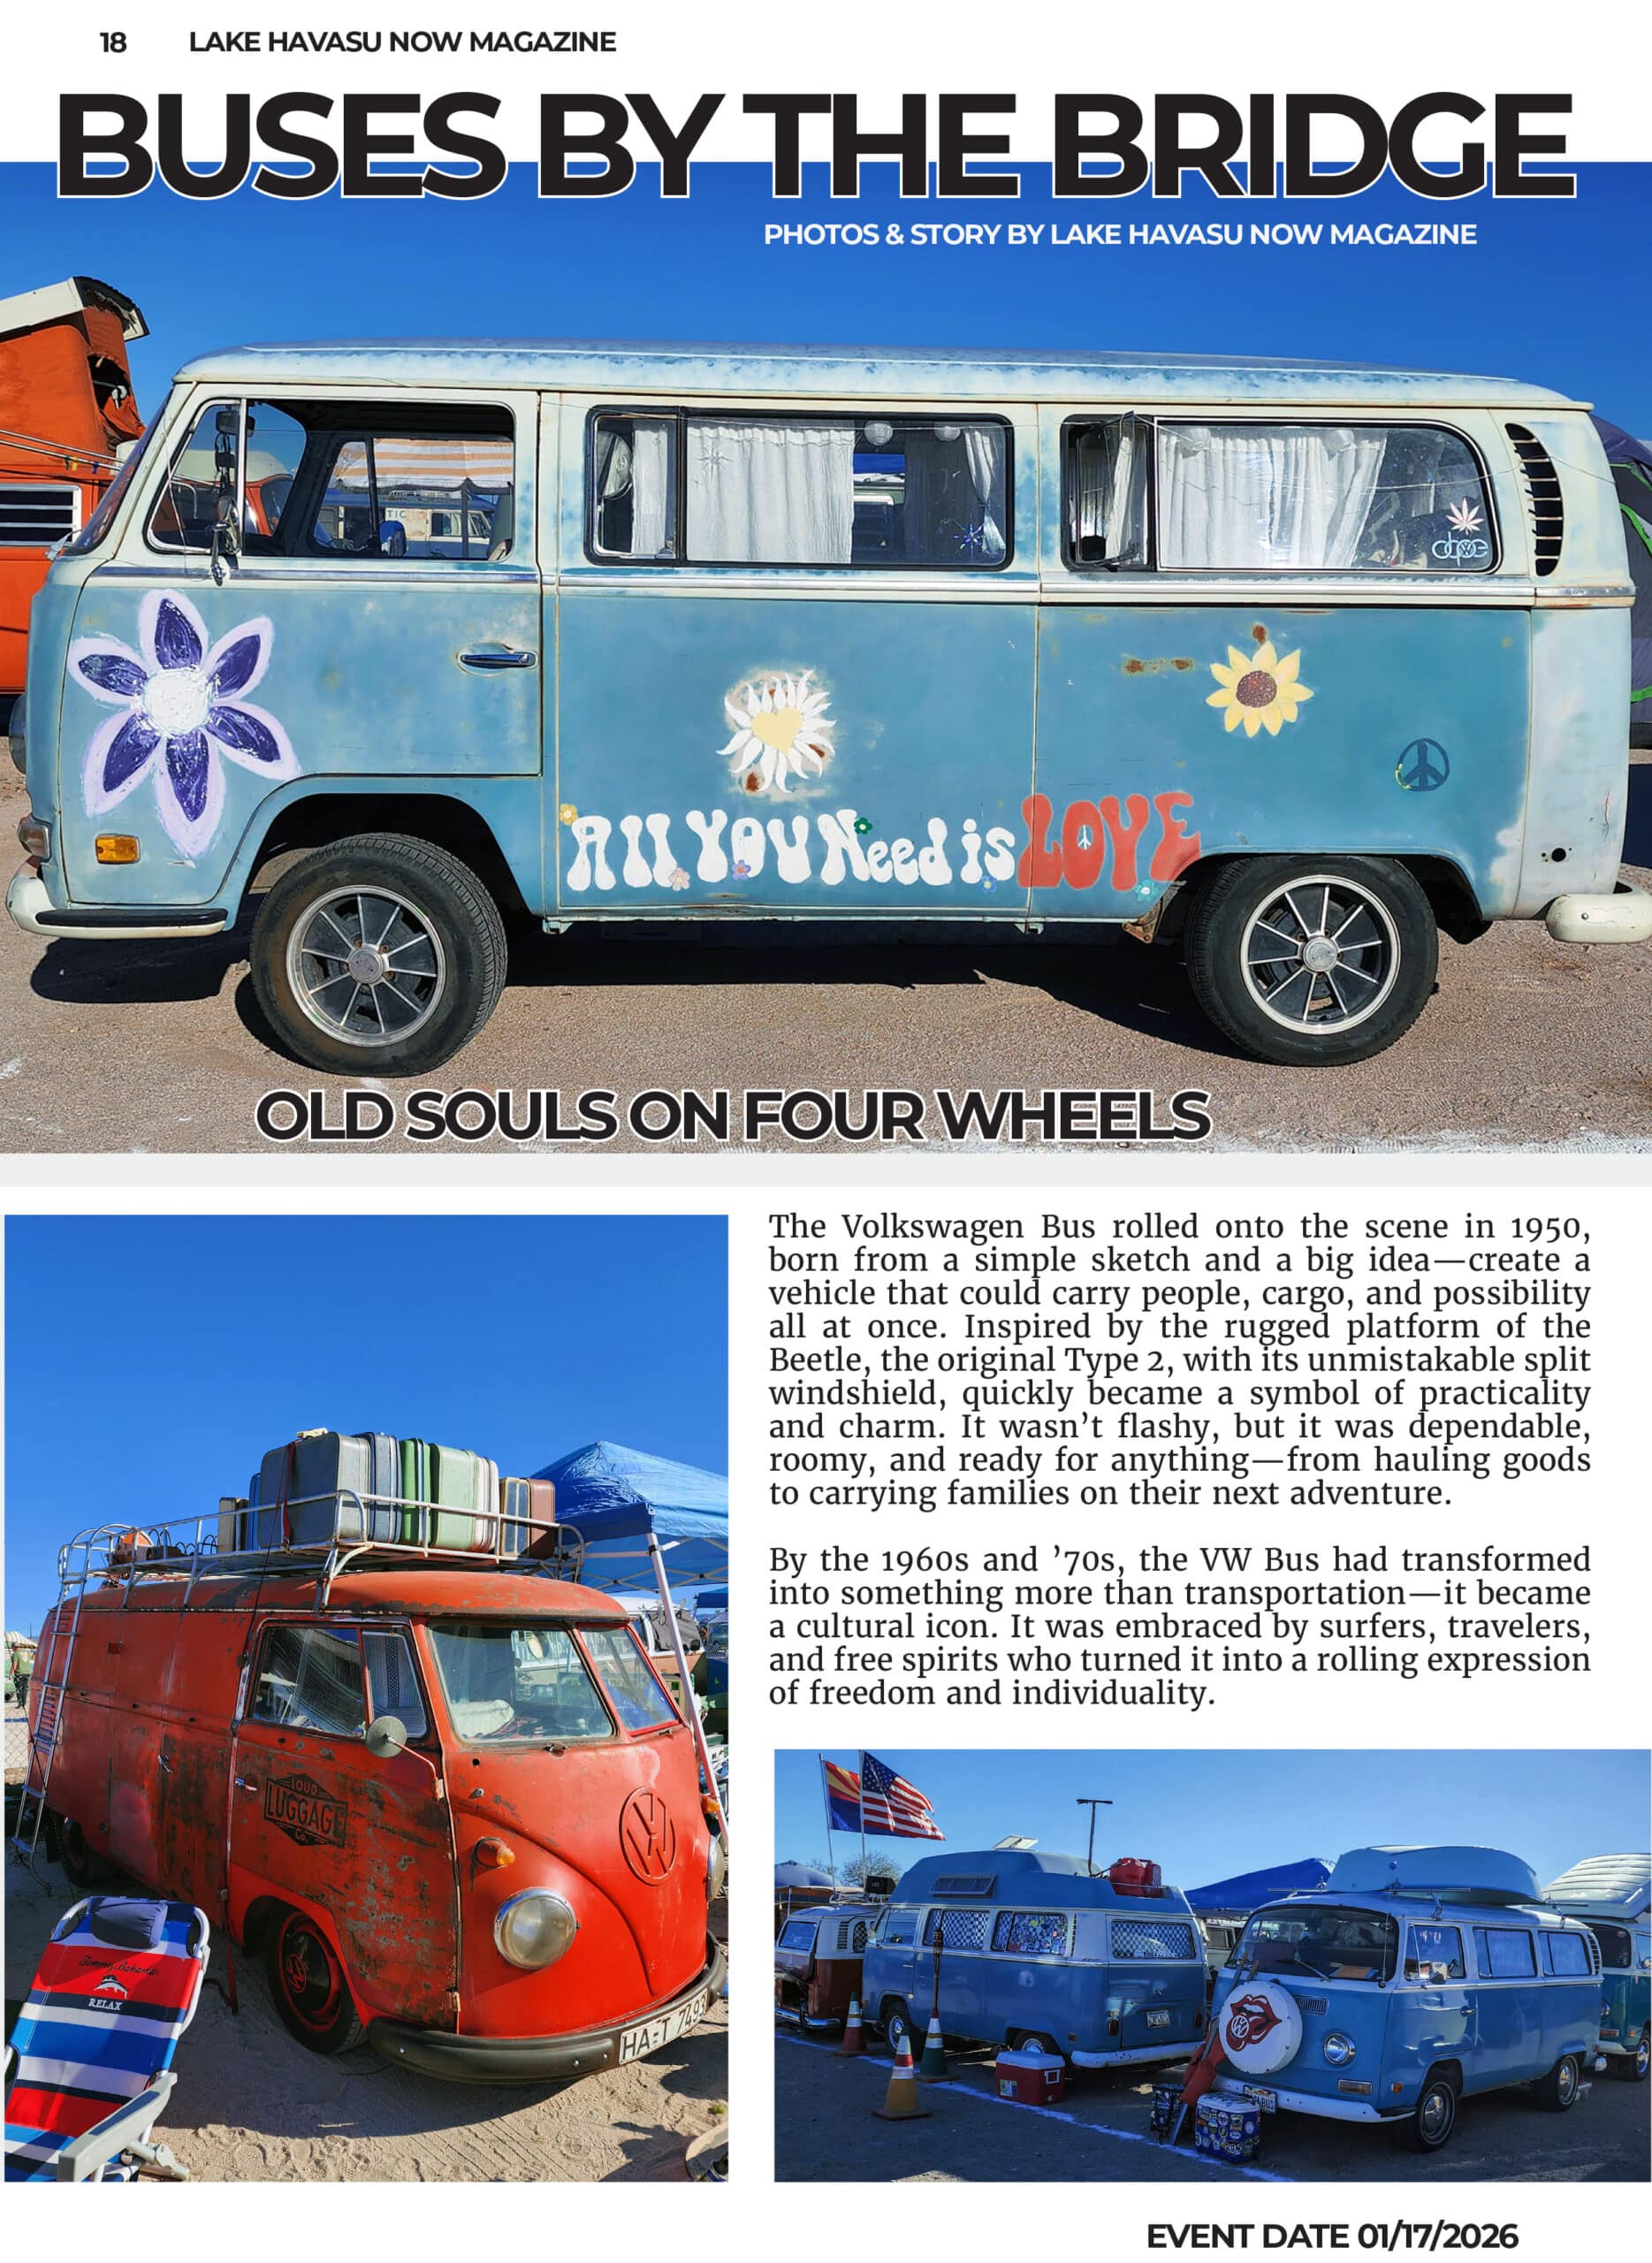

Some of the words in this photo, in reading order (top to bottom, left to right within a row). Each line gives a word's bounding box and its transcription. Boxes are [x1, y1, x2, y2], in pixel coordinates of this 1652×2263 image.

[100, 32, 126, 53] 18
[191, 32, 261, 52] LAKE
[270, 31, 381, 52] HAVASU
[391, 31, 462, 52] NOW
[471, 31, 616, 52] MAGAZINE
[686, 810, 808, 884] YOU
[820, 808, 952, 885] Need
[961, 819, 1016, 883] is
[1018, 793, 1200, 890] LOVE
[769, 1213, 826, 1238] The
[841, 1213, 1024, 1246] Volkswagen
[1042, 1215, 1094, 1238] Bus
[1113, 1213, 1198, 1238] rolled
[1216, 1216, 1283, 1238] onto
[1301, 1213, 1348, 1238] the
[1367, 1220, 1448, 1238] scene
[1465, 1213, 1495, 1238] in
[1512, 1218, 1589, 1244] 1950,
[769, 1246, 839, 1271] born
[855, 1246, 928, 1271] from
[944, 1253, 958, 1271] a
[976, 1246, 1075, 1278] simple
[1092, 1246, 1190, 1271] sketch
[1206, 1246, 1260, 1271] and
[1277, 1253, 1291, 1271] a
[1306, 1246, 1353, 1279] big
[1575, 1253, 1590, 1271] a
[769, 1279, 875, 1305] vehicle
[887, 1279, 948, 1305] that
[961, 1279, 1040, 1305] could
[1053, 1287, 1130, 1312] carry
[1142, 1279, 1249, 1312] people,
[1263, 1287, 1352, 1313] cargo,
[1367, 1279, 1421, 1305] and
[1434, 1279, 1591, 1312] possibility
[770, 1313, 806, 1337] all
[824, 1316, 850, 1337] at
[869, 1320, 946, 1337] once.
[966, 1313, 1090, 1345] Inspired
[1108, 1313, 1143, 1345] by
[1161, 1313, 1207, 1337] the
[1225, 1313, 1329, 1345] rugged
[1347, 1312, 1479, 1345] platform
[1497, 1312, 1526, 1337] of
[1543, 1313, 1590, 1337] the
[770, 1345, 870, 1377] Beetle,
[881, 1345, 928, 1371] the
[939, 1345, 1055, 1379] original
[1065, 1348, 1138, 1378] Type
[1148, 1352, 1173, 1377] 2,
[1183, 1345, 1252, 1371] with
[1262, 1350, 1298, 1371] its
[1308, 1345, 1514, 1371] unmistakable
[1526, 1345, 1591, 1378] split
[769, 1379, 945, 1411] windshield,
[963, 1379, 1073, 1412] quickly
[1088, 1379, 1202, 1405] became
[1218, 1387, 1233, 1405] a
[1251, 1379, 1359, 1412] symbol
[1375, 1379, 1405, 1405] of
[1420, 1379, 1591, 1412] practicality
[770, 1413, 824, 1437] and
[840, 1413, 944, 1437] charm.
[962, 1414, 985, 1437] It
[1000, 1412, 1102, 1437] wasn’t
[1118, 1412, 1218, 1445] flashy,
[1234, 1413, 1284, 1437] but
[1299, 1413, 1321, 1437] it
[1335, 1420, 1393, 1437] was
[1410, 1413, 1589, 1444] dependable,
[770, 1453, 874, 1478] roomy,
[891, 1445, 945, 1471] and
[959, 1446, 1042, 1478] ready
[1055, 1445, 1098, 1471] for
[1374, 1445, 1490, 1479] hauling
[1504, 1445, 1590, 1479] goods
[770, 1483, 798, 1505] to
[810, 1480, 936, 1512] carrying
[948, 1479, 1069, 1505] families
[1081, 1487, 1117, 1505] on
[1130, 1479, 1201, 1505] their
[1214, 1483, 1279, 1505] next
[1290, 1479, 1450, 1505] adventure.
[770, 1548, 807, 1578] By
[820, 1546, 868, 1571] the
[883, 1547, 968, 1575] 1960s
[984, 1546, 1038, 1571] and
[1054, 1545, 1123, 1577] ’70s,
[1139, 1546, 1187, 1571] the
[1200, 1548, 1252, 1571] VW
[1266, 1548, 1319, 1571] Bus
[1333, 1546, 1388, 1571] had
[1402, 1545, 1591, 1571] transformed
[770, 1580, 829, 1604] into
[841, 1579, 1003, 1612] something
[1016, 1587, 1092, 1604] more
[1104, 1579, 1173, 1604] than
[1477, 1579, 1590, 1604] became
[770, 1619, 785, 1638] a
[797, 1612, 914, 1638] cultural
[926, 1612, 997, 1638] icon.
[1011, 1614, 1034, 1637] It
[1046, 1619, 1103, 1638] was
[1116, 1612, 1261, 1638] embraced
[1273, 1612, 1308, 1645] by
[1321, 1612, 1435, 1643] surfers,
[1448, 1612, 1589, 1643] travelers,
[770, 1646, 824, 1671] and
[834, 1645, 892, 1671] free
[903, 1646, 997, 1678] spirits
[1008, 1646, 1070, 1671] who
[1081, 1646, 1181, 1671] turned
[1191, 1646, 1213, 1671] it
[1223, 1646, 1282, 1671] into
[1292, 1653, 1307, 1671] a
[1318, 1646, 1418, 1679] rolling
[1428, 1646, 1591, 1678] expression
[770, 1679, 799, 1704] of
[810, 1679, 935, 1704] freedom
[948, 1679, 1001, 1704] and
[1013, 1679, 1214, 1711] individuality.
[291, 1777, 318, 1796] LOUD
[267, 1784, 345, 1838] LUGGAGE
[88, 1998, 122, 2011] RELAX
[1148, 2224, 1254, 2248] EVENT
[1264, 2224, 1349, 2248] DATE
[1359, 2220, 1519, 2252] 01/17/2026
